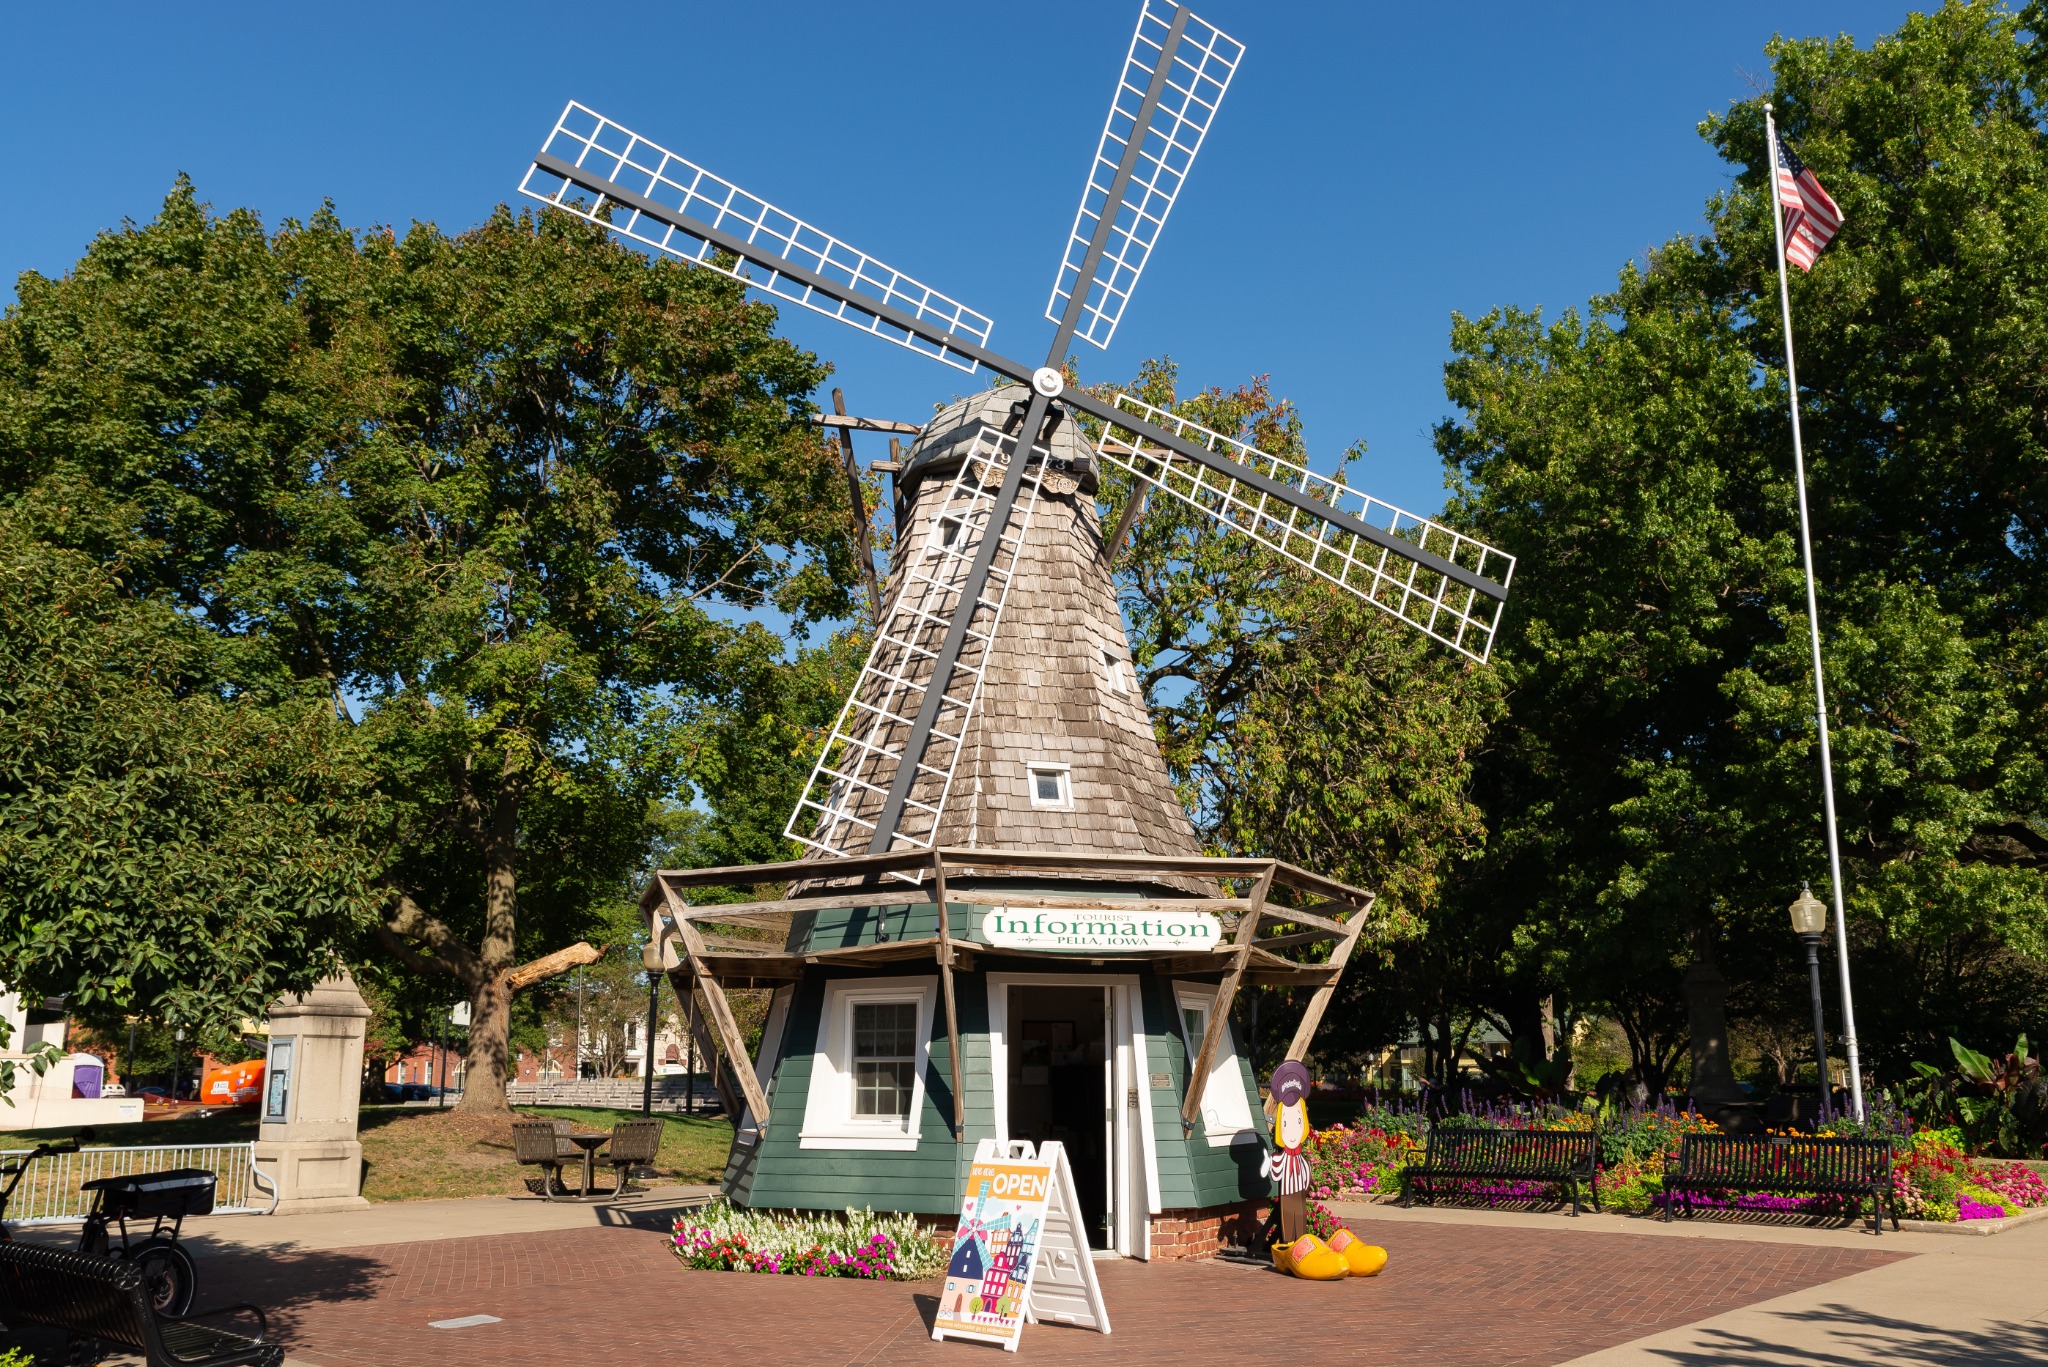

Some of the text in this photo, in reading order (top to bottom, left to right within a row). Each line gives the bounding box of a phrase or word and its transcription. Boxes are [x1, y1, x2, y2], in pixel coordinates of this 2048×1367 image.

[1073, 913, 1133, 922] TOURIST
[993, 913, 1210, 937] Information
[1057, 936, 1149, 947] PELLA, IOWA
[972, 1167, 995, 1177] we are
[992, 1173, 1047, 1197] OPEN
